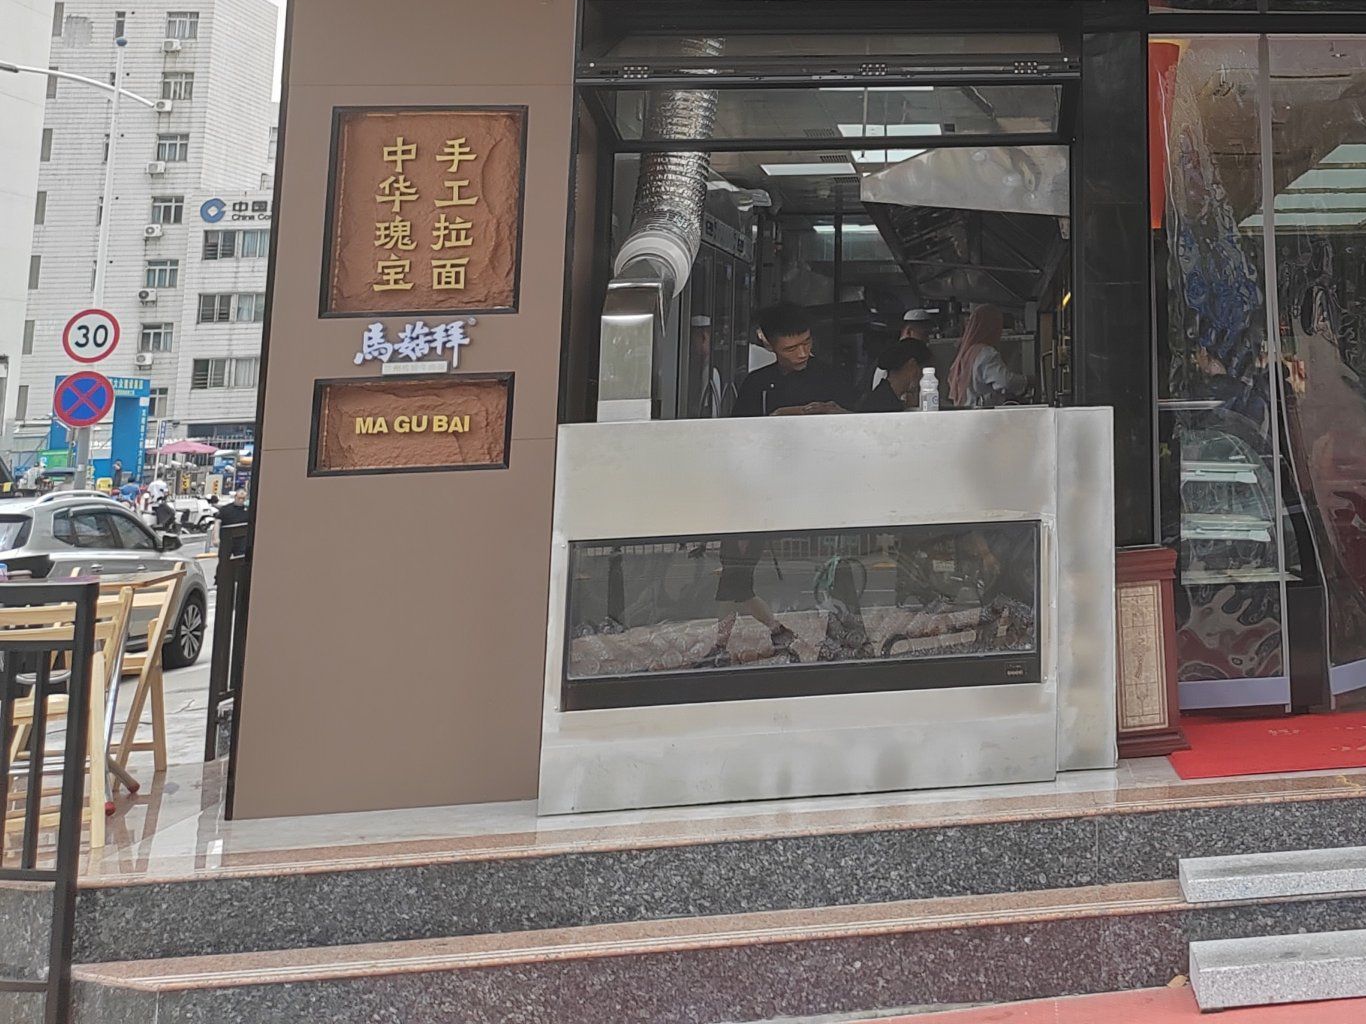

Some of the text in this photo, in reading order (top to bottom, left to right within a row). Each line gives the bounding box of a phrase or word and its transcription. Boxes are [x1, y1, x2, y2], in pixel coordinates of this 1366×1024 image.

[372, 136, 420, 293] 中华瑰宝
[430, 136, 479, 291] 手工拉面
[74, 324, 109, 348] 30
[355, 415, 471, 434] MA GU BAI
